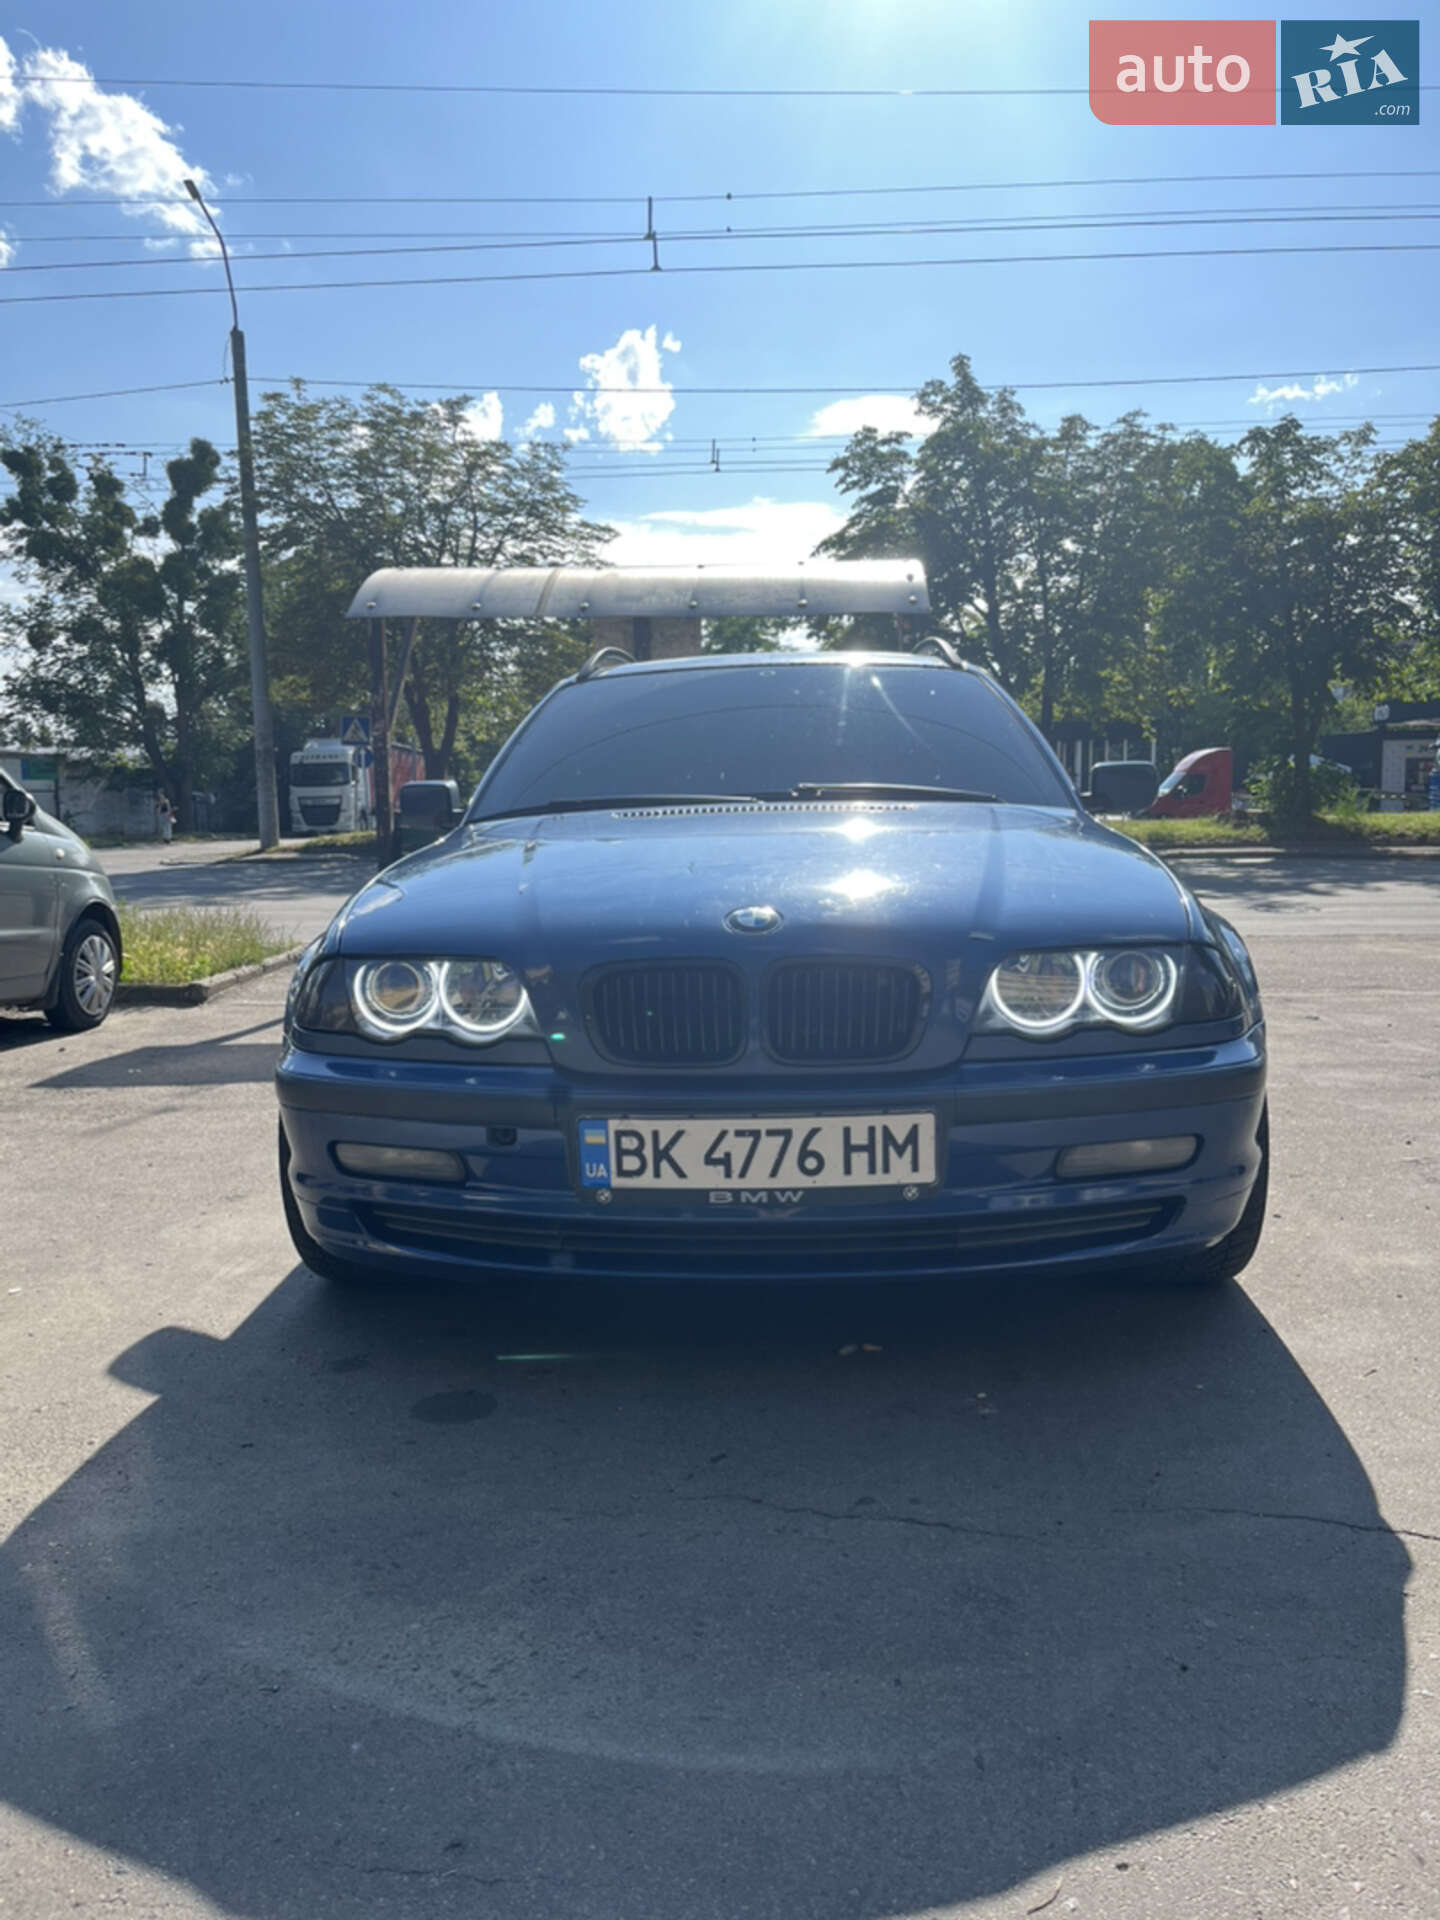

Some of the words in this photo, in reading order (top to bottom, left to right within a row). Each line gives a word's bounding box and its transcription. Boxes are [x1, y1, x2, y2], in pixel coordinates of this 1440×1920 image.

[613, 1128, 687, 1180] BK
[703, 1128, 825, 1179] 4776
[842, 1123, 920, 1176] HM
[585, 1164, 608, 1178] UA
[708, 1190, 805, 1204] BMW
